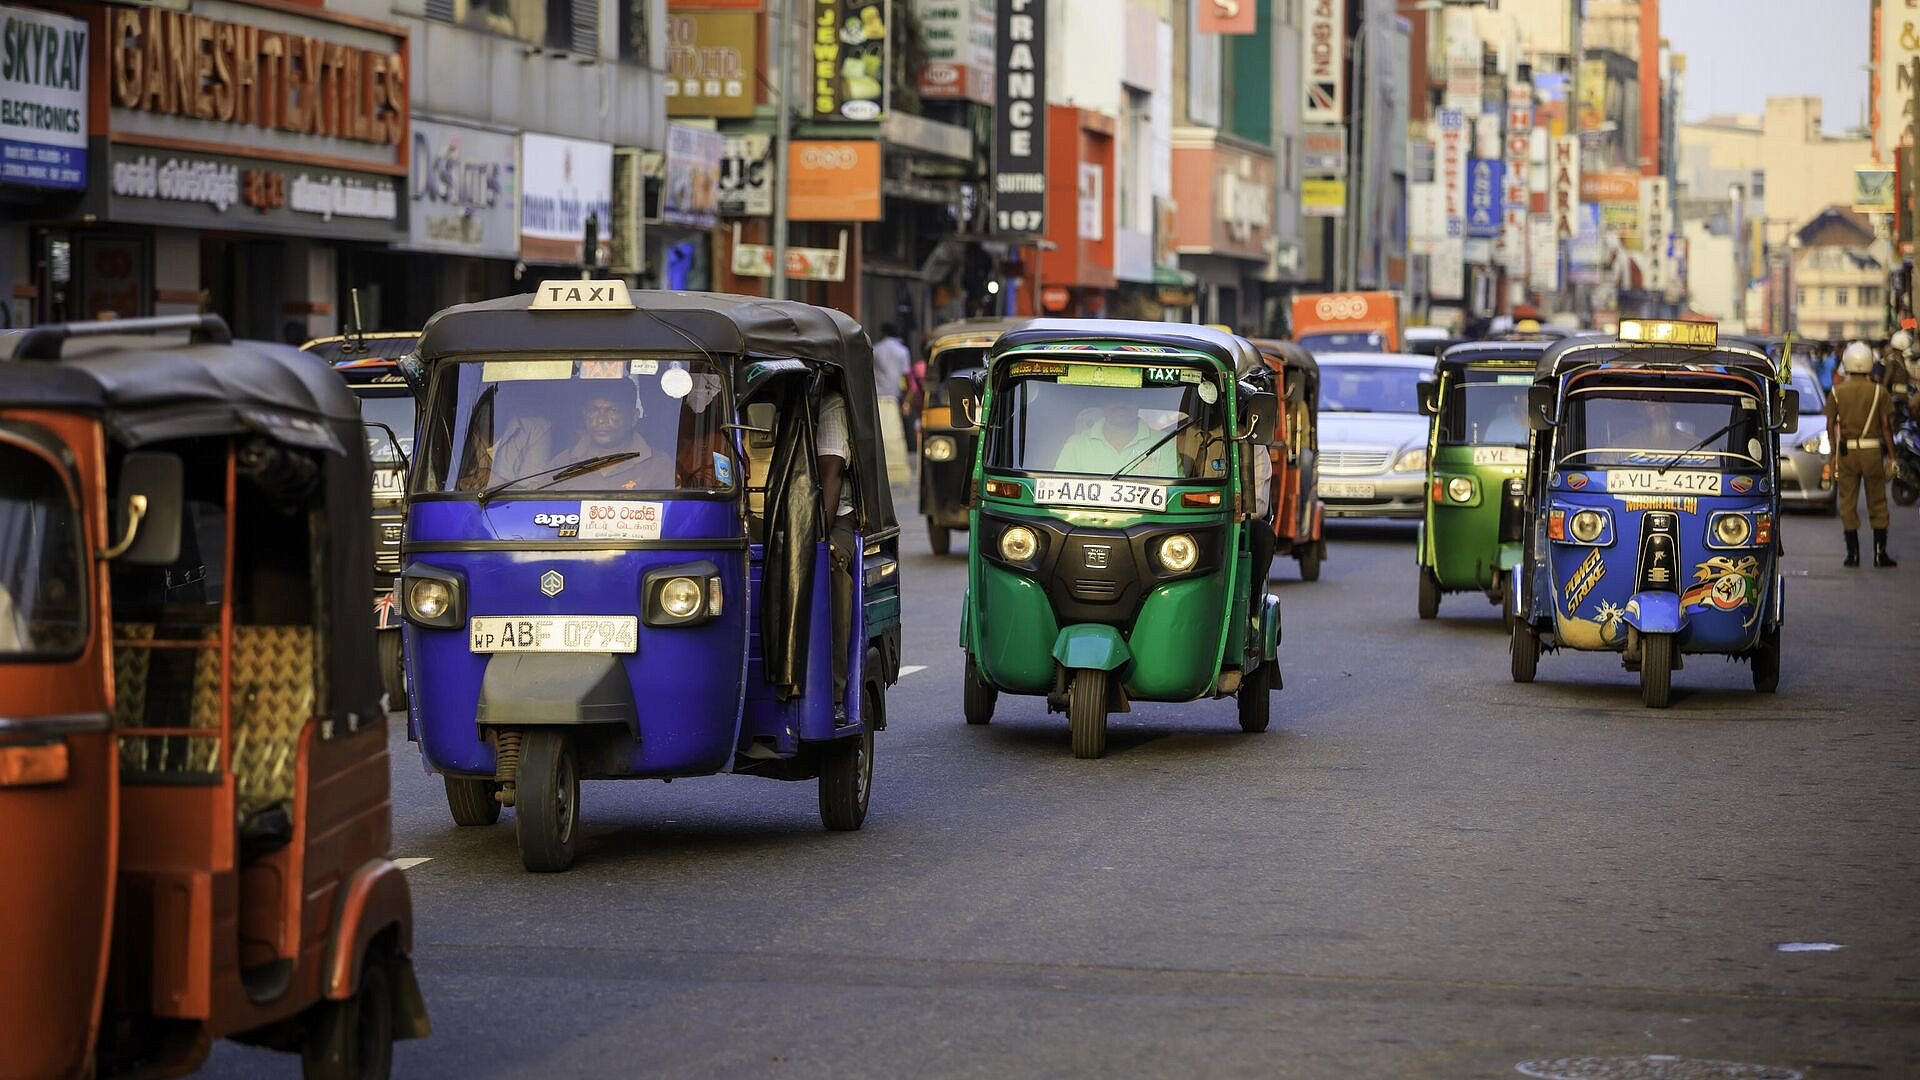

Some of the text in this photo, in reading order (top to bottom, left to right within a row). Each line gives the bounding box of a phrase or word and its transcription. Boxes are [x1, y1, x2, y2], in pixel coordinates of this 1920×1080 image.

[3, 17, 85, 91] SKYRAY
[814, 9, 839, 113] JEWELS
[2, 99, 81, 135] ELECTRONICS
[998, 210, 1042, 230] 107
[549, 287, 616, 302] TAXI
[1059, 482, 1101, 501] AAQ
[1110, 484, 1163, 506] 3376
[1628, 473, 1651, 488] YU
[1673, 474, 1718, 491] 4172
[534, 513, 580, 528] ape
[1565, 547, 1600, 599] POWER
[1568, 560, 1606, 616] STROKE
[475, 621, 633, 648] WP ABF 0794
